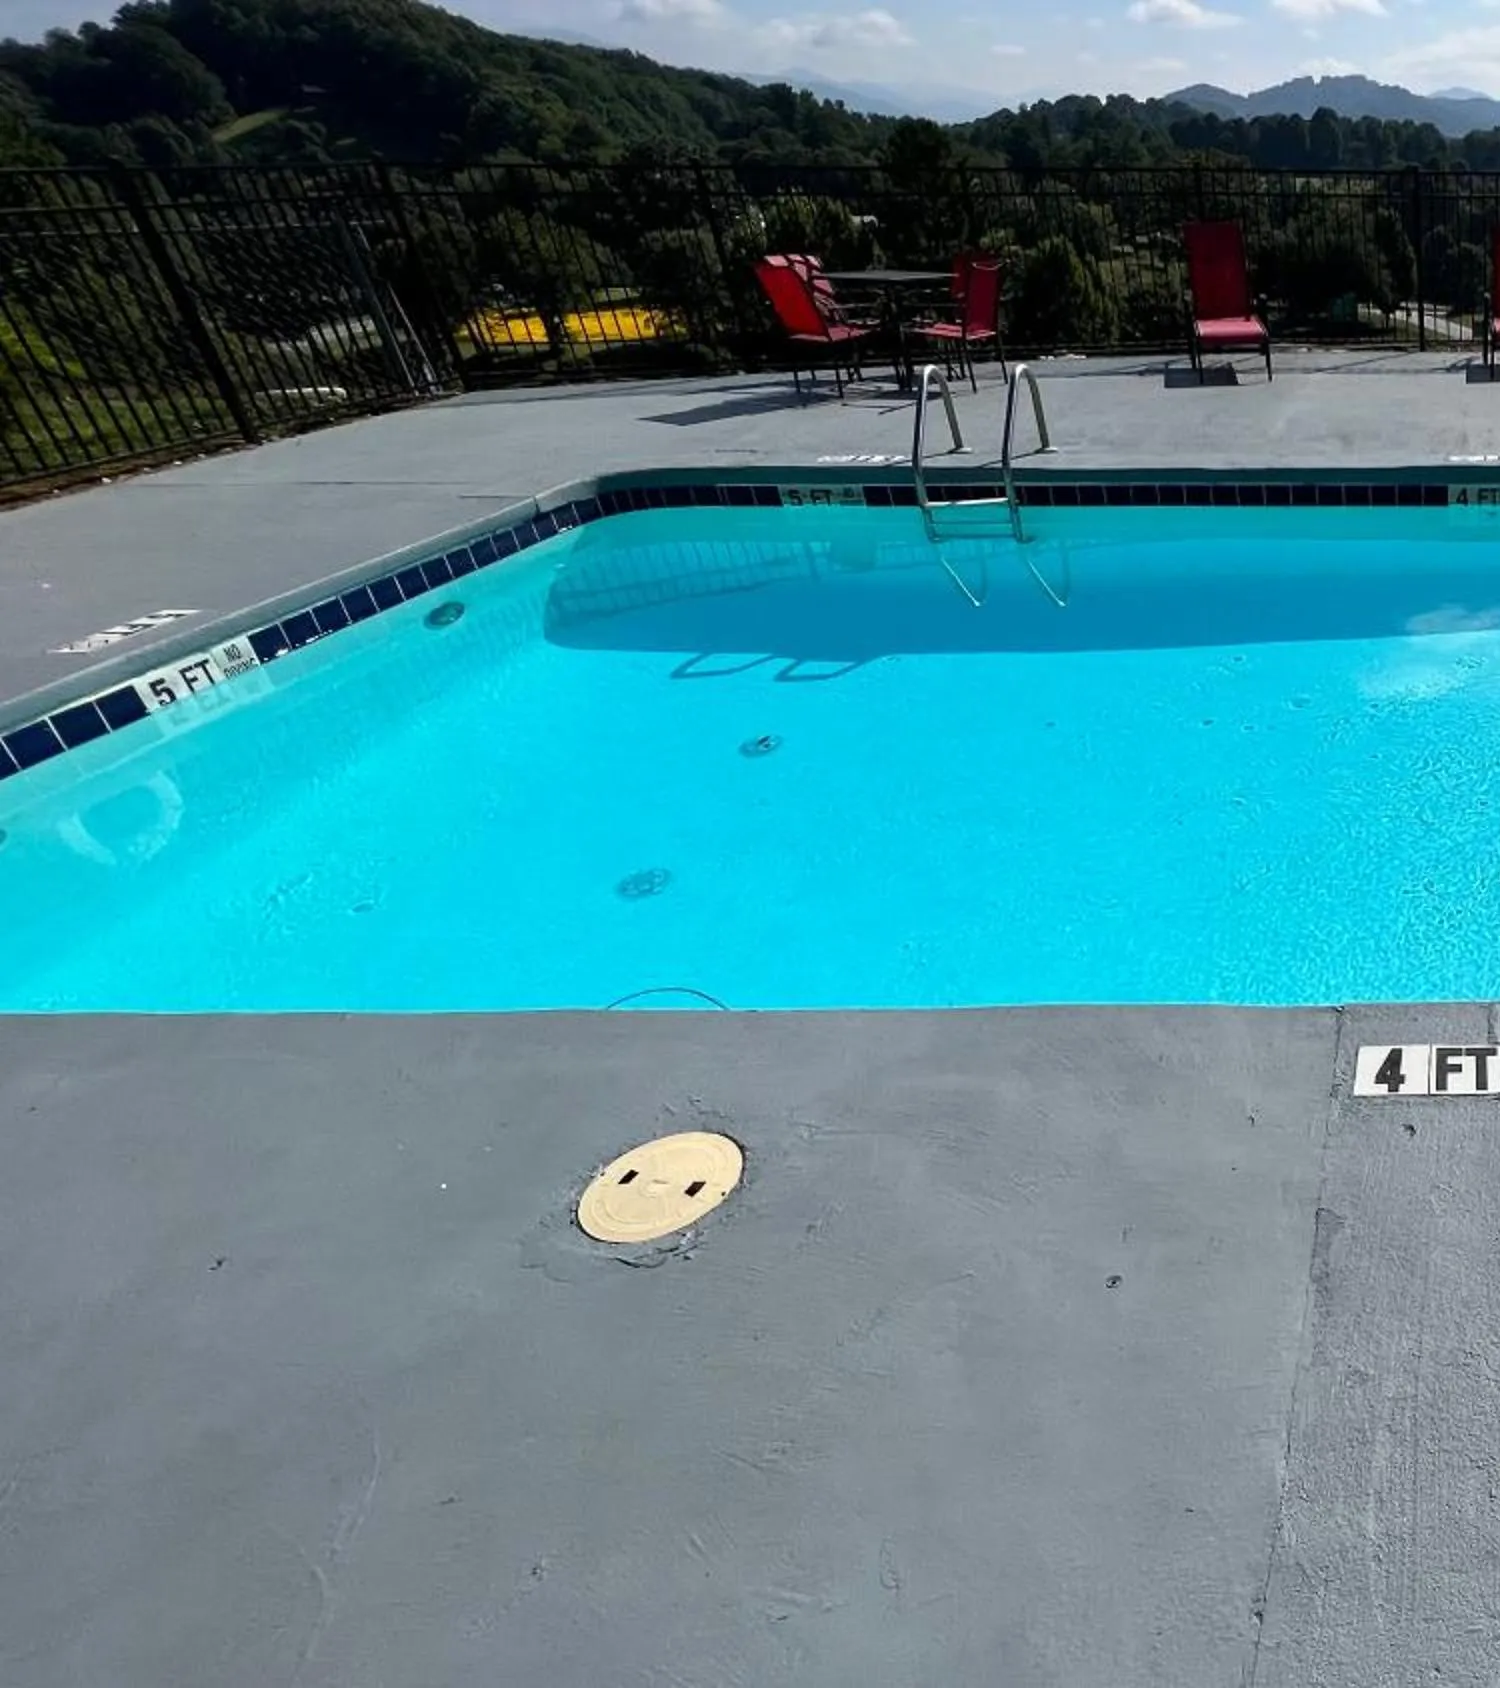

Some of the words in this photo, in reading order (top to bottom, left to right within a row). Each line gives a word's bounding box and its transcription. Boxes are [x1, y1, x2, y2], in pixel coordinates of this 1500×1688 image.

[810, 488, 833, 506] FT
[1456, 488, 1469, 506] 4
[1477, 488, 1500, 505] FT
[150, 677, 177, 706] 5
[178, 658, 216, 693] FT
[1374, 1047, 1406, 1093] 4
[1435, 1047, 1497, 1092] FT
